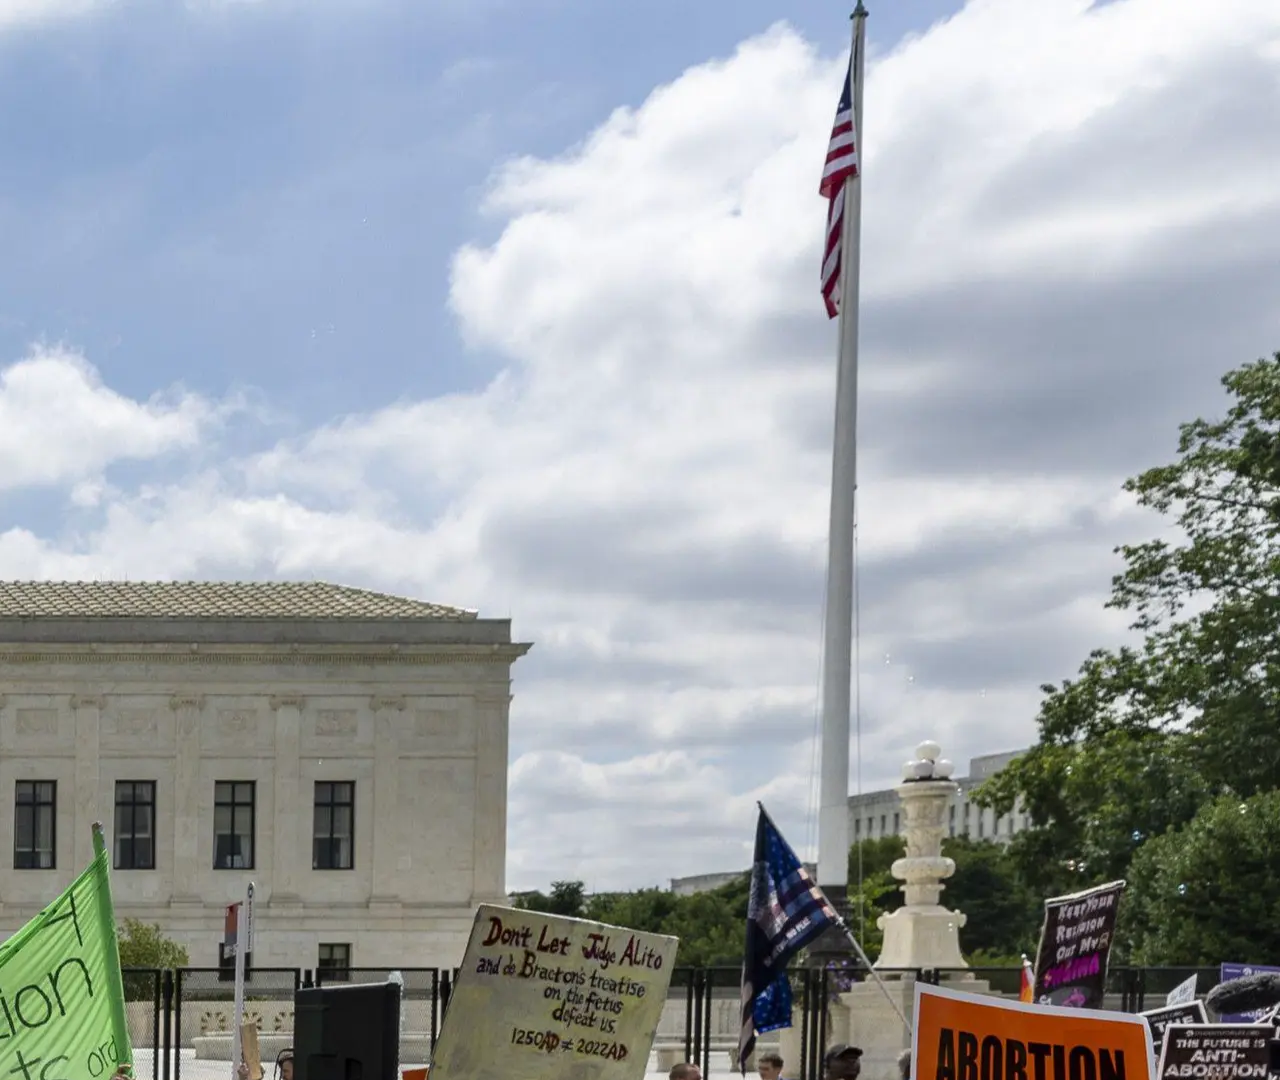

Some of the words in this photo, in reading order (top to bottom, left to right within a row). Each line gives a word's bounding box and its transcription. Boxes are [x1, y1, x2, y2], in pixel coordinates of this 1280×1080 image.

[482, 917, 532, 947] Don't
[537, 925, 571, 955] Let
[582, 933, 616, 969] Judge
[476, 954, 502, 975] and
[518, 950, 585, 985] Bracton's
[589, 969, 646, 998] treatise
[544, 986, 561, 1000] on
[567, 987, 584, 1005] the
[585, 992, 624, 1014] fetus
[552, 1001, 597, 1028] defeat
[511, 1027, 560, 1053] 1250AD
[577, 1038, 628, 1060] 2022AD
[1176, 1039, 1199, 1048] THE
[1203, 1039, 1250, 1048] FUTURE
[1254, 1039, 1266, 1048] IS
[1190, 1050, 1246, 1063] ANTI-
[1164, 1064, 1268, 1078] ABORTION
